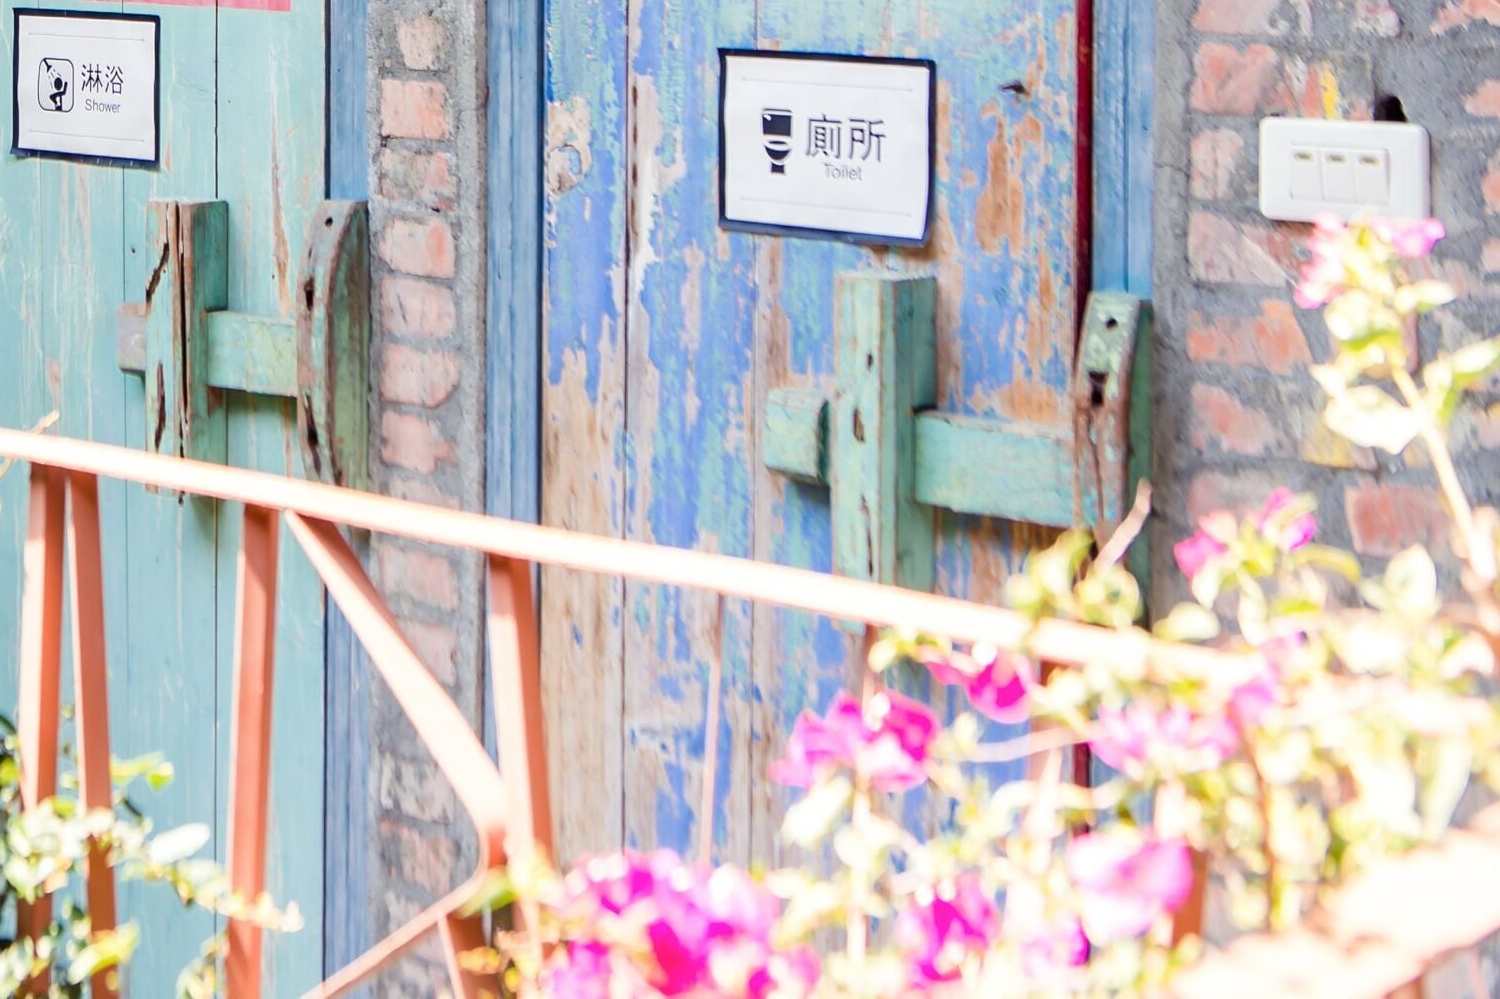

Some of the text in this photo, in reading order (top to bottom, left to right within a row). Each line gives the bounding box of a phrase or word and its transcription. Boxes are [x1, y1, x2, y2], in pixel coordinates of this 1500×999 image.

[81, 63, 124, 95] 淋浴
[85, 99, 121, 113] Shower
[805, 113, 887, 163] 廁所
[824, 162, 863, 181] Toilet
